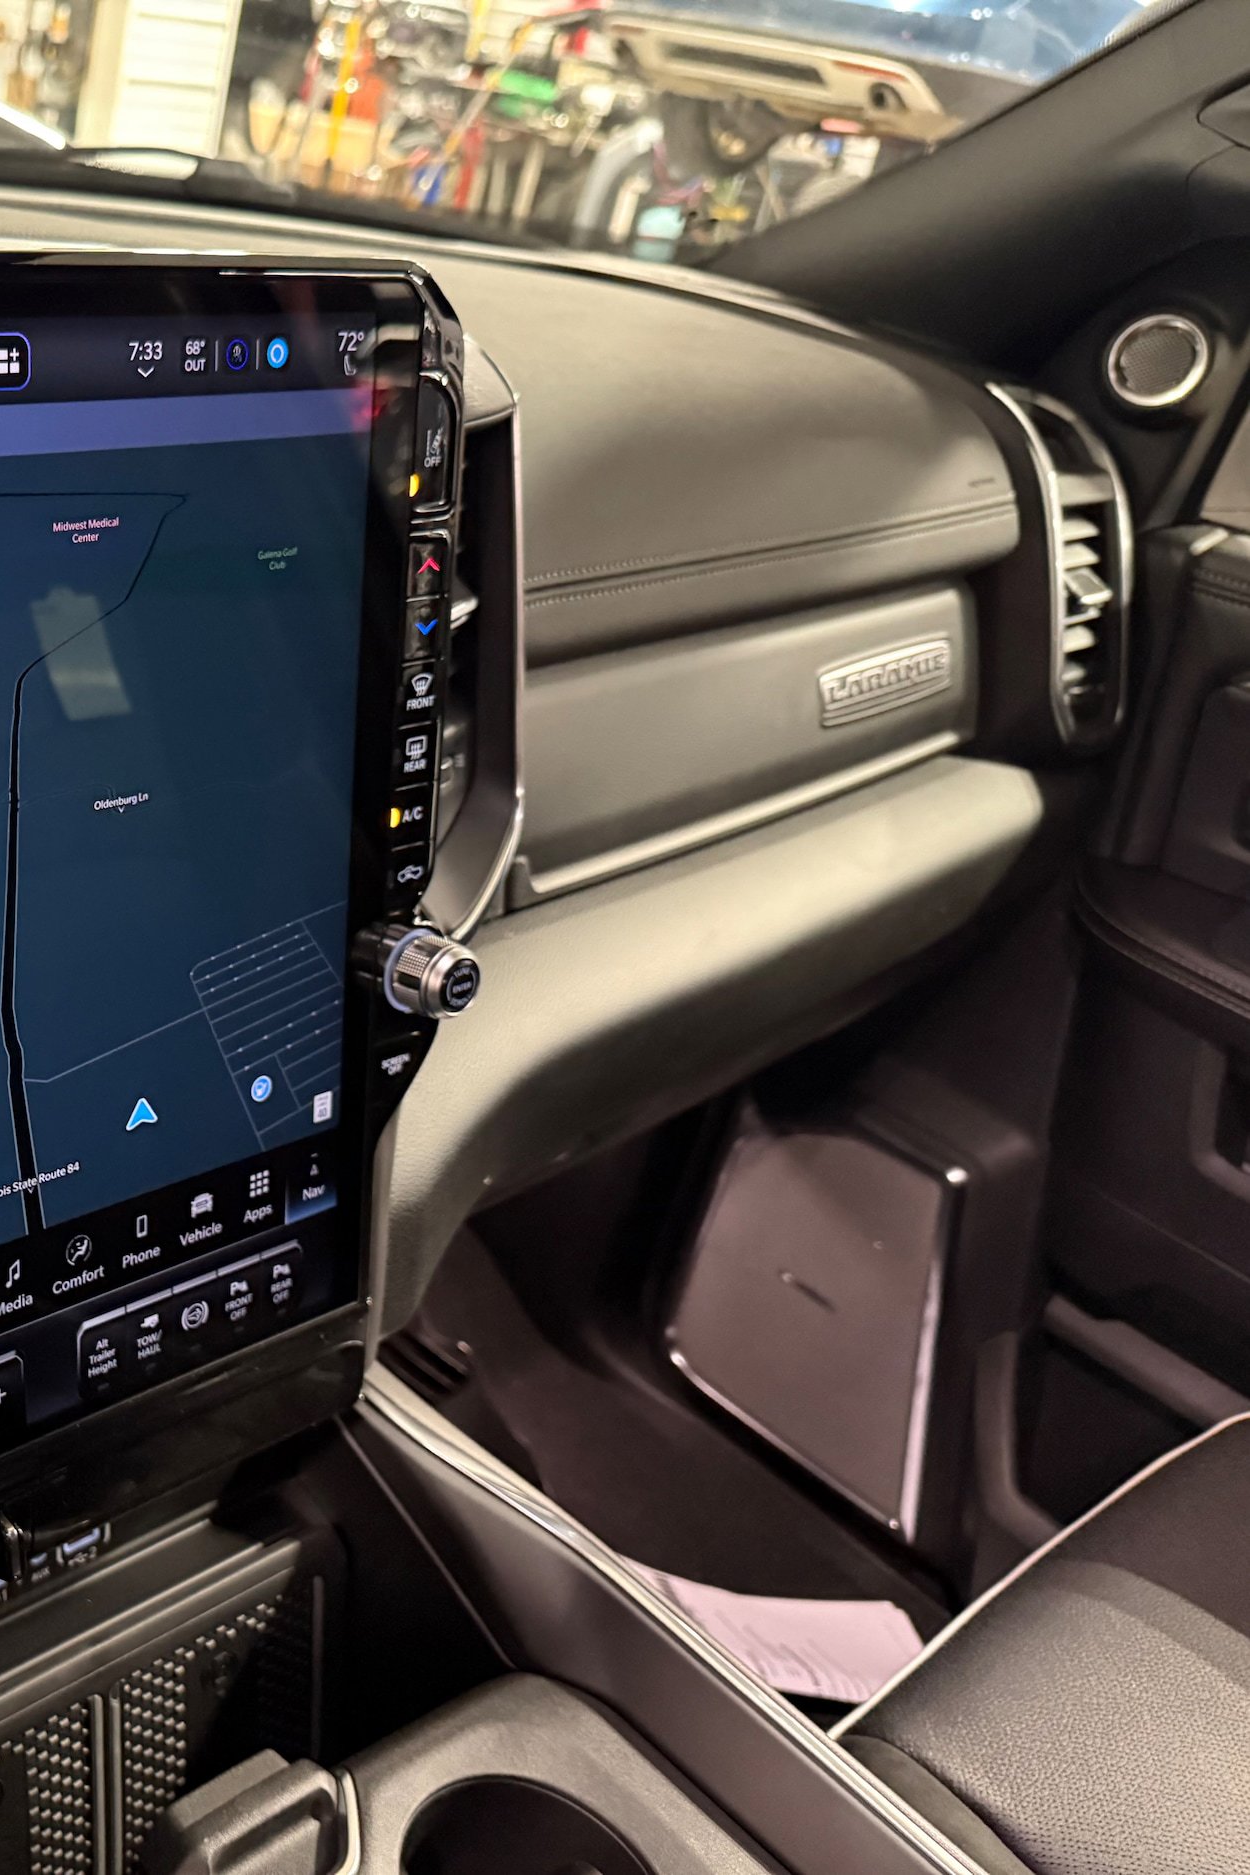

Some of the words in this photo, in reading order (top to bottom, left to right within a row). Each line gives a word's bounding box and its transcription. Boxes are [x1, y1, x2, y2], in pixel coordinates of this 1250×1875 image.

[128, 341, 163, 362] 7:33
[184, 359, 206, 373] OUT
[424, 455, 442, 468] OFF
[52, 520, 87, 533] Midwest
[88, 516, 120, 529] Medical
[71, 532, 99, 543] Center
[406, 694, 437, 711] FRONT
[403, 759, 427, 774] REAR
[93, 796, 138, 812] Oldenburg
[402, 805, 424, 824] A/C
[11, 1177, 38, 1193] State
[37, 1167, 67, 1184] Route
[66, 1161, 80, 1174] 84
[302, 1184, 326, 1201] Nav
[243, 1203, 273, 1224] Apps
[179, 1221, 224, 1248] Vehicle
[122, 1245, 162, 1270] Phone
[52, 1264, 106, 1296] Comfort
[95, 1338, 109, 1351] Alt
[137, 1343, 162, 1360] HAUL
[89, 1347, 116, 1364] Trailer
[87, 1358, 118, 1378] Height
